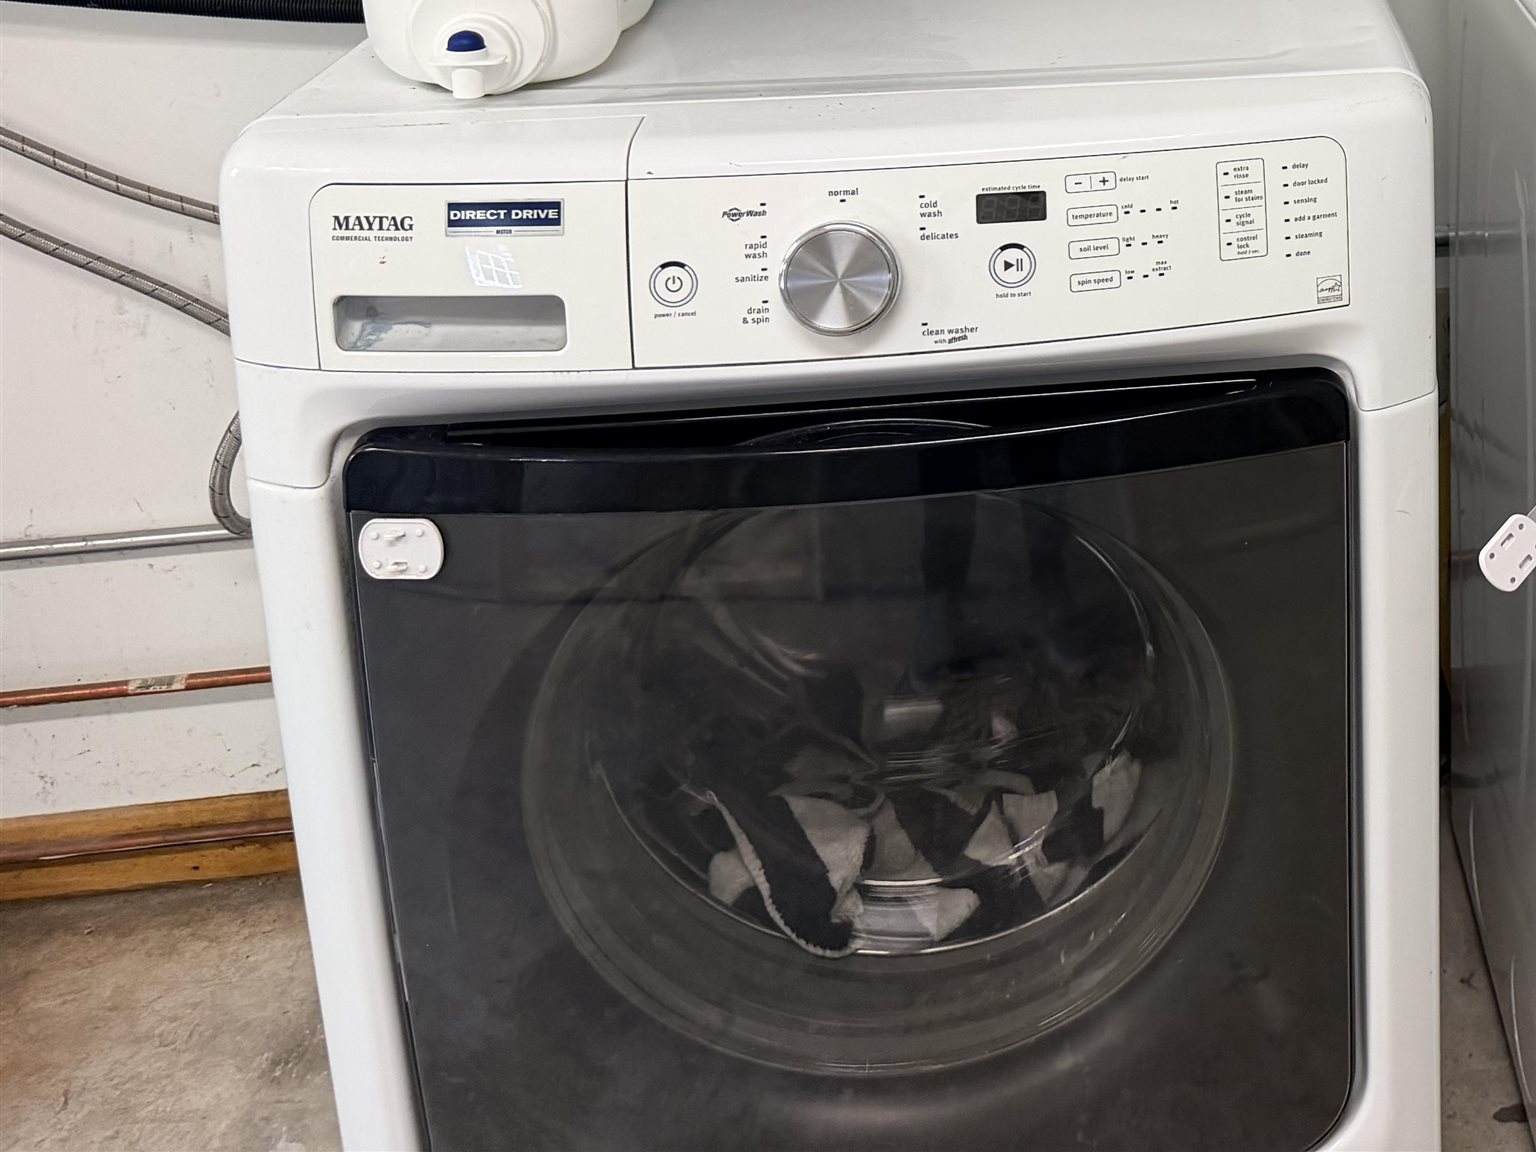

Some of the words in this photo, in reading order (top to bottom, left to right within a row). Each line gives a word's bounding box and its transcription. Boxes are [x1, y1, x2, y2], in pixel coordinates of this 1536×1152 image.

[828, 188, 859, 197] normal
[450, 210, 508, 221] DIRECT
[511, 209, 559, 219] DRIVE
[920, 210, 942, 218] wash
[1072, 212, 1113, 220] temperature
[1312, 212, 1337, 221] garment
[332, 215, 413, 231] MAYTAG
[745, 242, 767, 250] rapid
[745, 251, 768, 259] wash
[735, 274, 769, 282] sanitize
[752, 317, 769, 325] spin
[922, 328, 945, 336] clean
